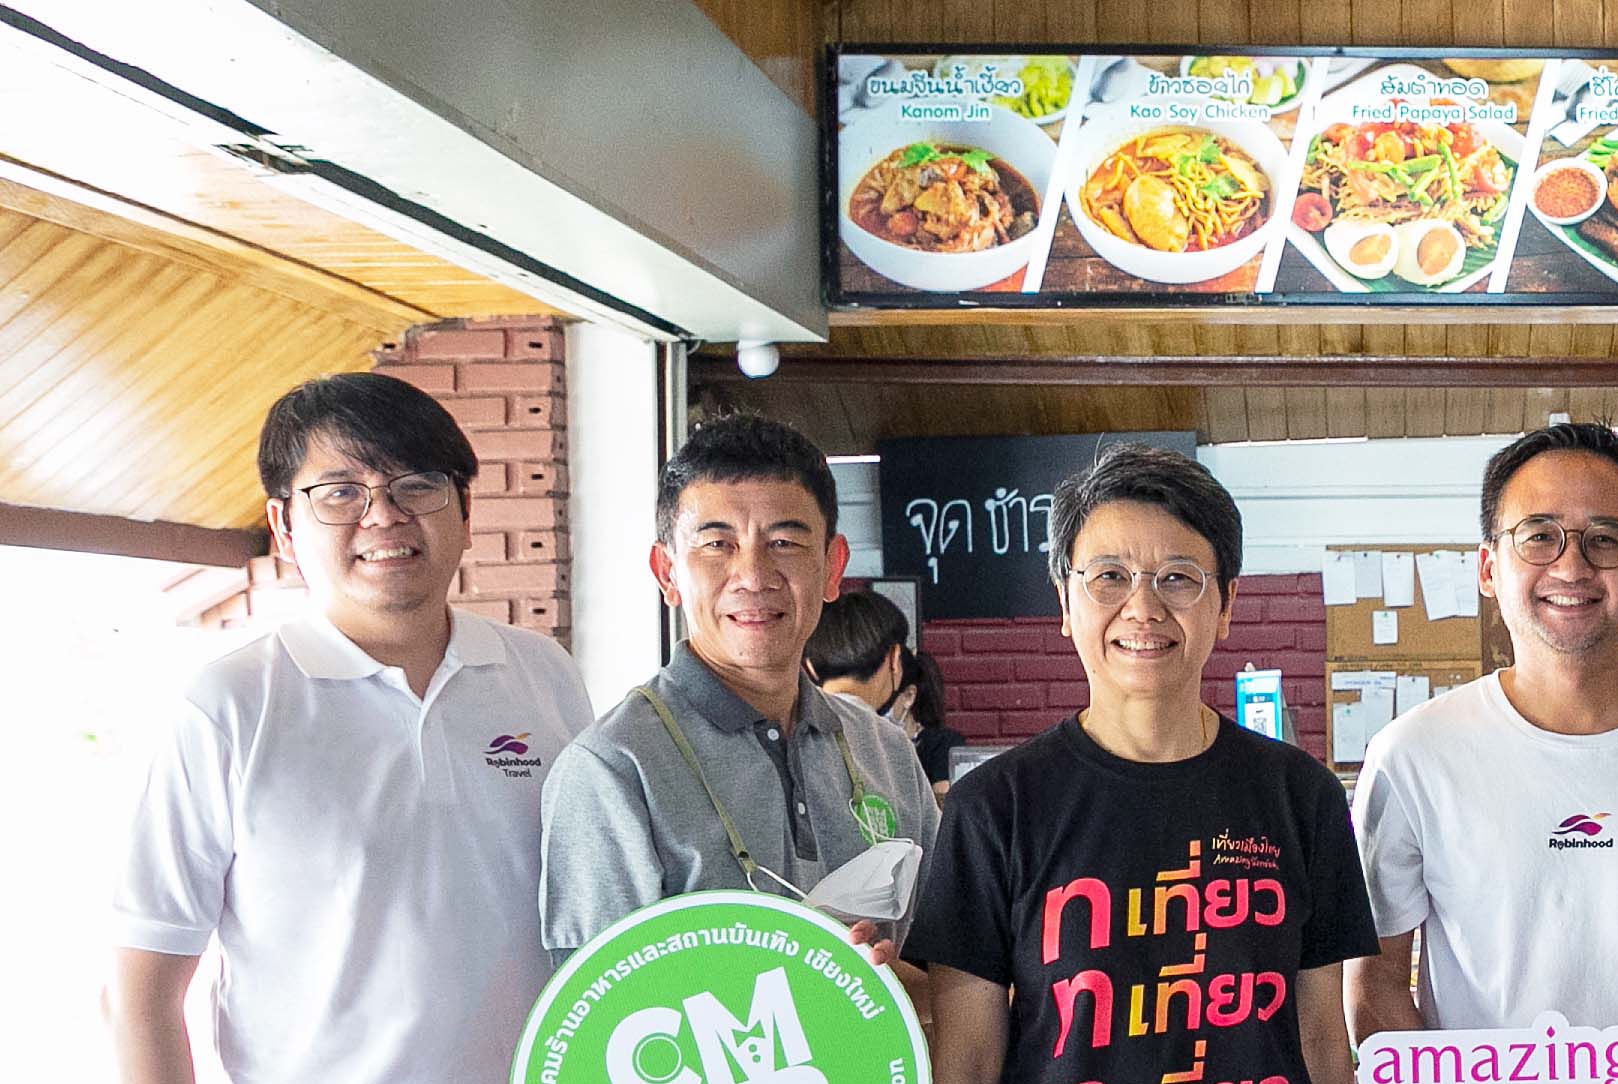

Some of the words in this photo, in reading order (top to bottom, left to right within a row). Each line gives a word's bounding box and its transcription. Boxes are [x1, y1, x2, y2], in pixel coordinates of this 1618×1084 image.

[869, 65, 1021, 94] ขนมจีนน้ำเงี้ยว
[1148, 72, 1250, 94] ข้าวซอยไก่
[1380, 74, 1486, 95] ส้มตำทอด
[901, 104, 959, 118] Kanom
[967, 104, 990, 118] Jin
[1130, 104, 1162, 118] Kao
[1169, 104, 1198, 121] Soy
[1205, 104, 1269, 119] Chicken
[1352, 105, 1392, 119] Fried
[1400, 105, 1460, 122] Papaya
[1468, 105, 1514, 120] Salad
[1580, 106, 1618, 121] Fried
[905, 498, 973, 585] จุด
[485, 756, 541, 769] Robinhood
[502, 768, 533, 778] Travel
[1548, 837, 1614, 851] Robinhood
[803, 948, 885, 1021] เชียงใหม่
